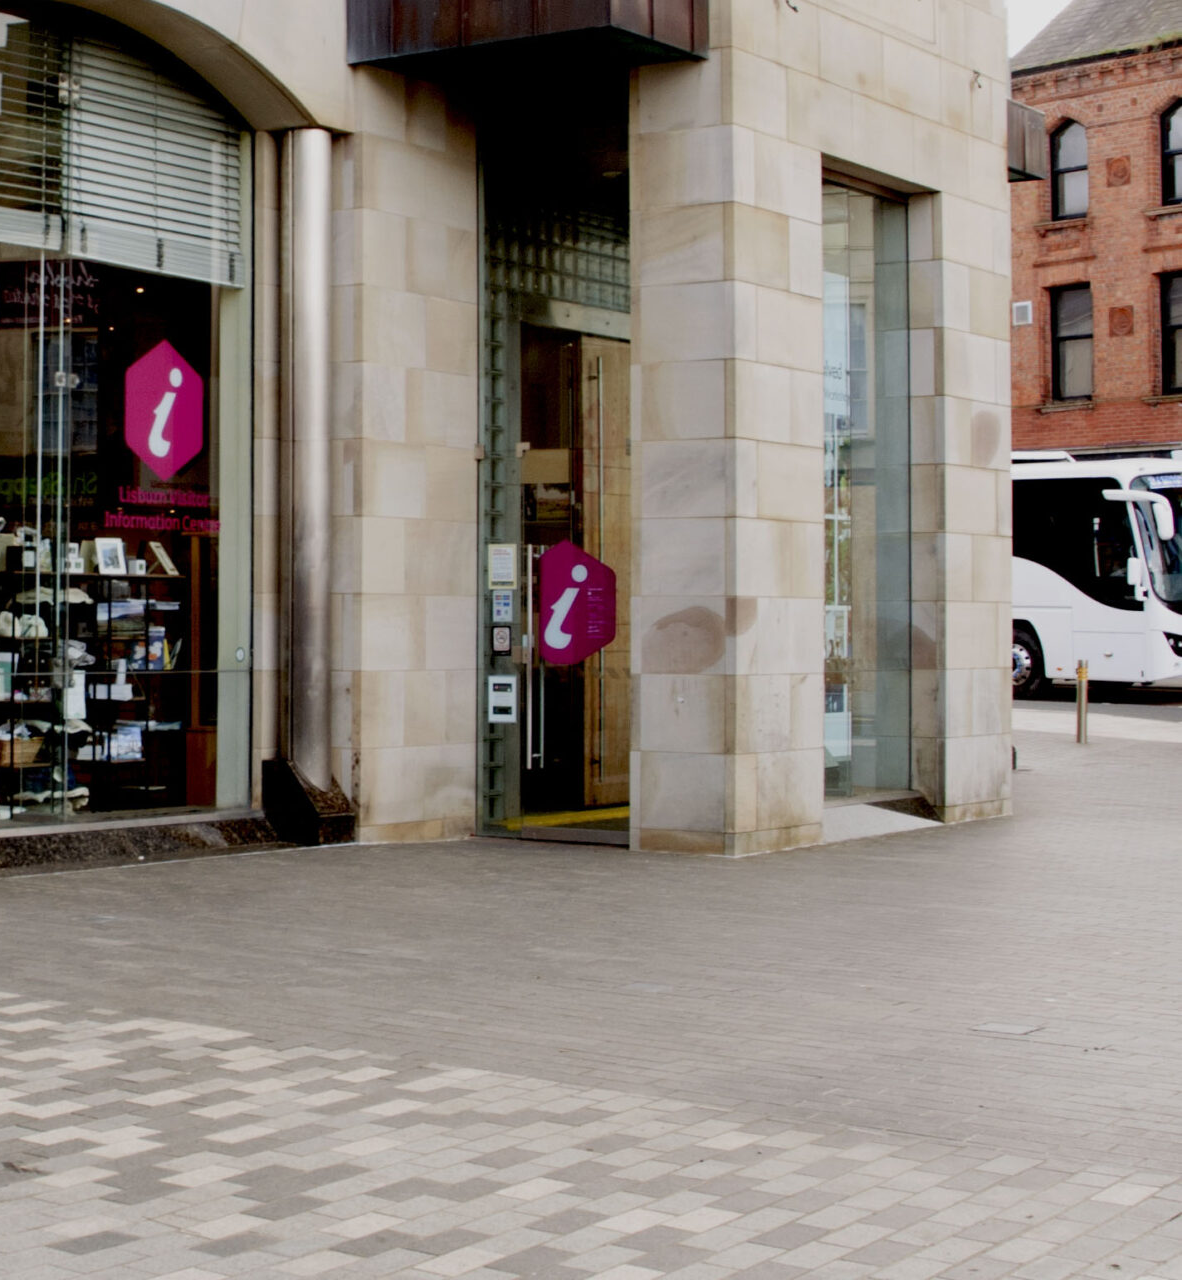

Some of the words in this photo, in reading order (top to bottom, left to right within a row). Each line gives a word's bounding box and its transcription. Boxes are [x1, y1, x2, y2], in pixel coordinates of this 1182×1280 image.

[118, 485, 165, 504] Lisburn
[167, 489, 210, 507] Visitor
[104, 510, 181, 530] Information
[182, 514, 221, 532] Centre
